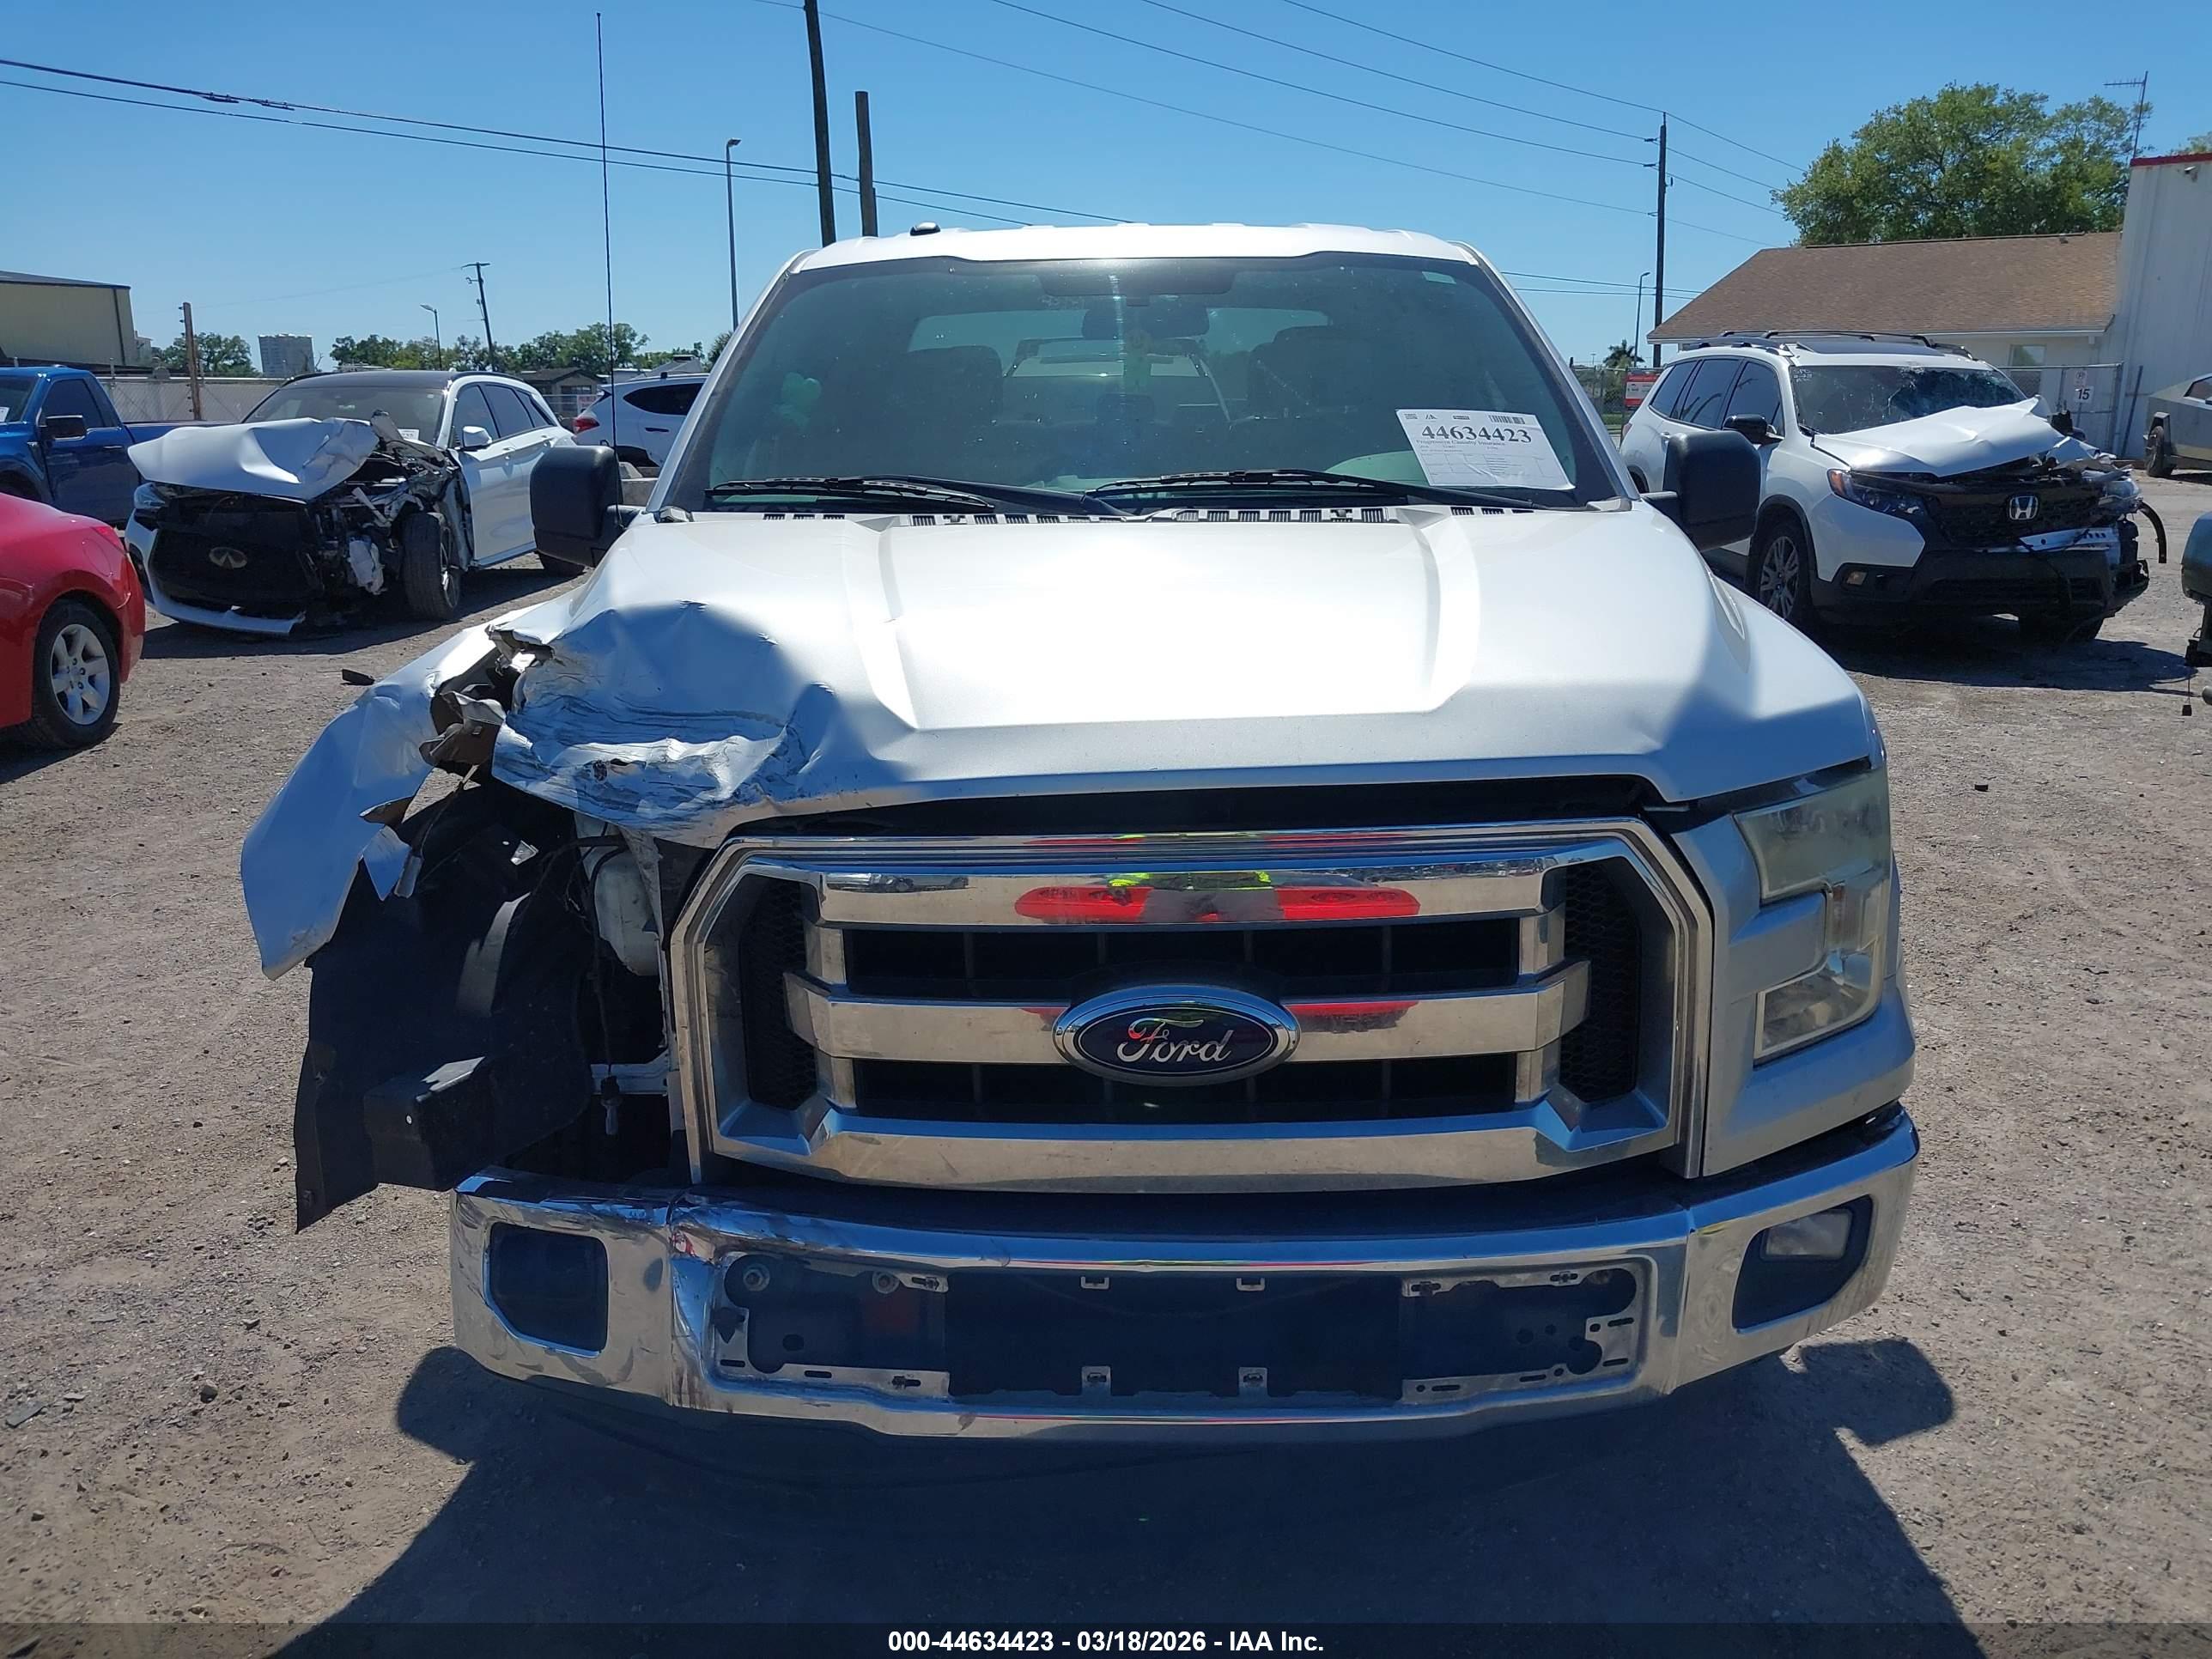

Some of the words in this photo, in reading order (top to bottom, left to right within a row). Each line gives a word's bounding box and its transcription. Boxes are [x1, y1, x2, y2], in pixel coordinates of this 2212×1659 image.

[2078, 388, 2091, 400] 15
[1421, 425, 1532, 443] 44634423
[1116, 1017, 1234, 1063] Ford
